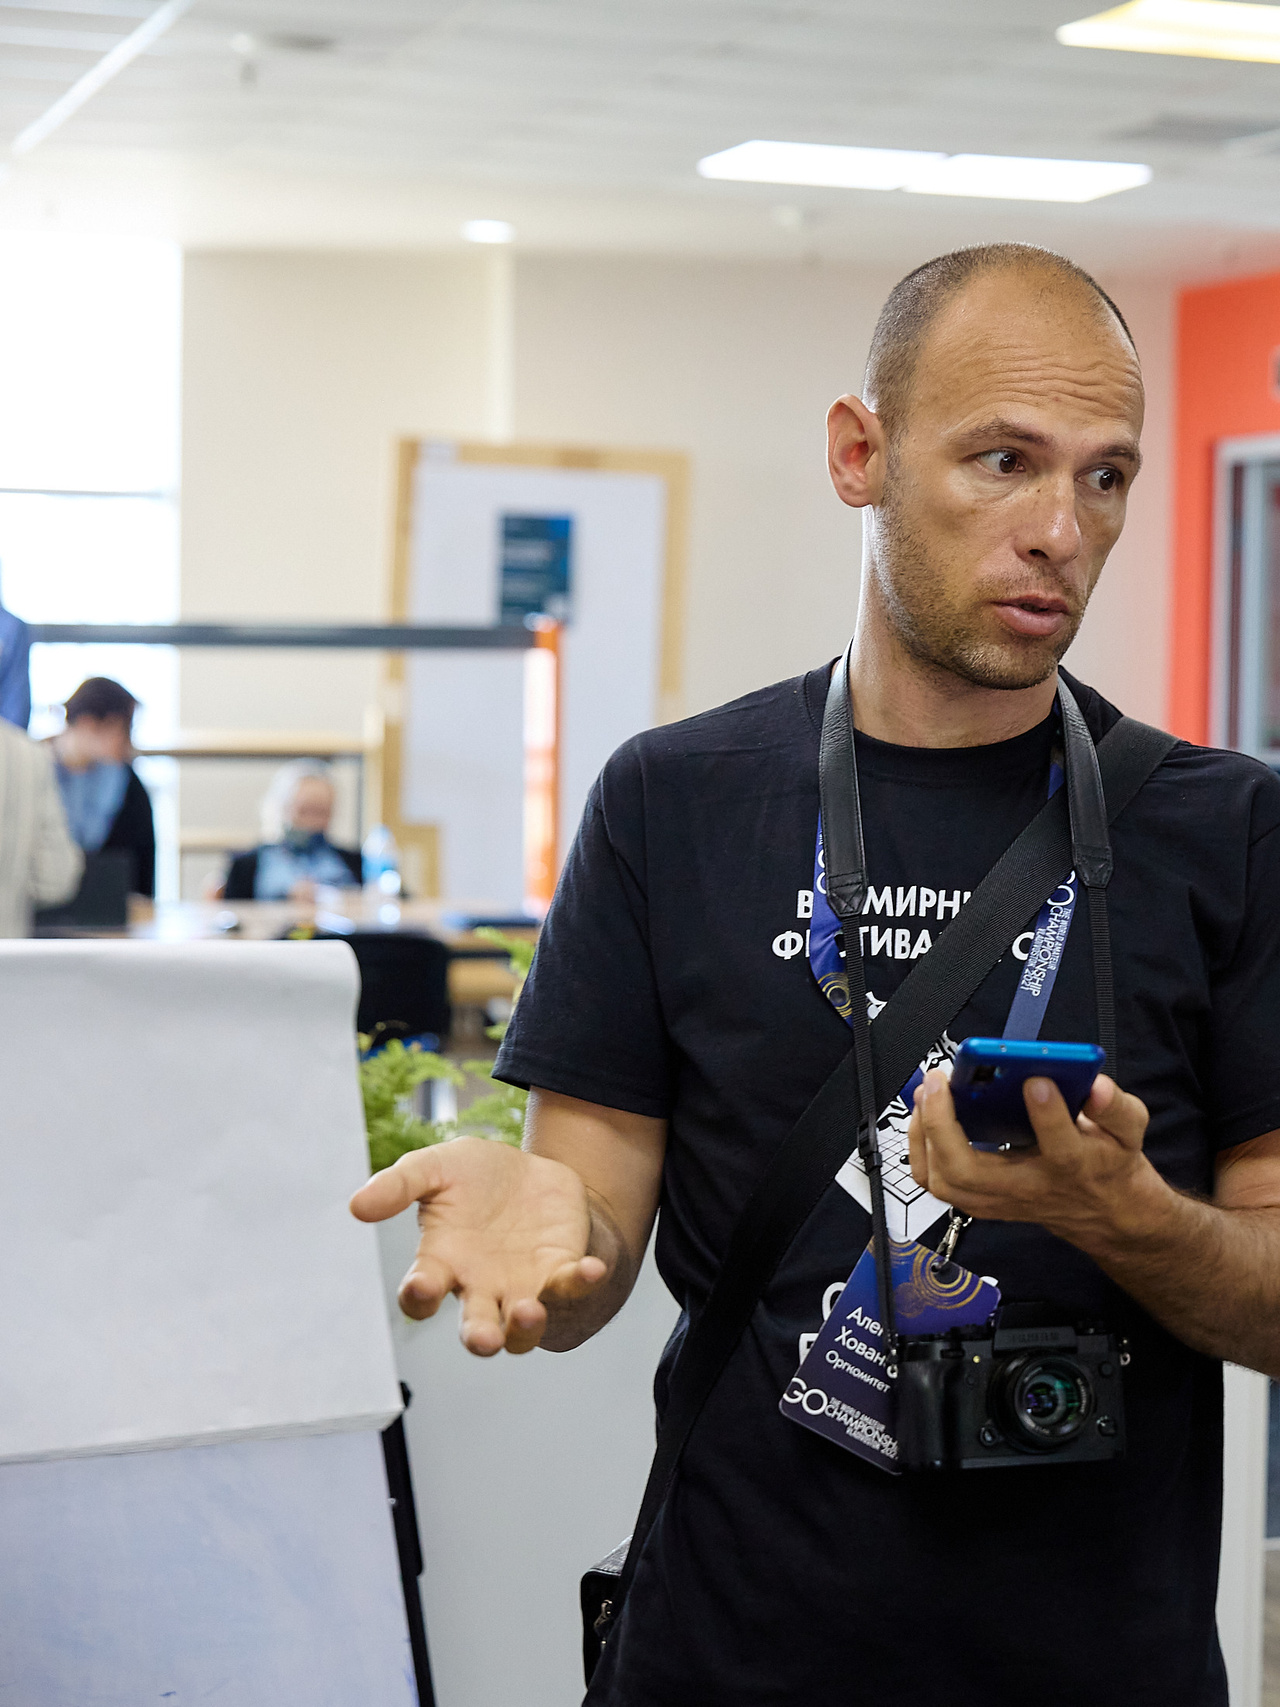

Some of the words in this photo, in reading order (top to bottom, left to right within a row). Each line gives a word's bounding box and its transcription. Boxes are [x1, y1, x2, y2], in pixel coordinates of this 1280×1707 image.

[797, 885, 972, 920] ВМИРН
[1031, 905, 1064, 997] CHAMPIONSHIP
[1020, 968, 1037, 991] 2021
[825, 1350, 891, 1393] Оргкомитет
[783, 1378, 828, 1415] GO
